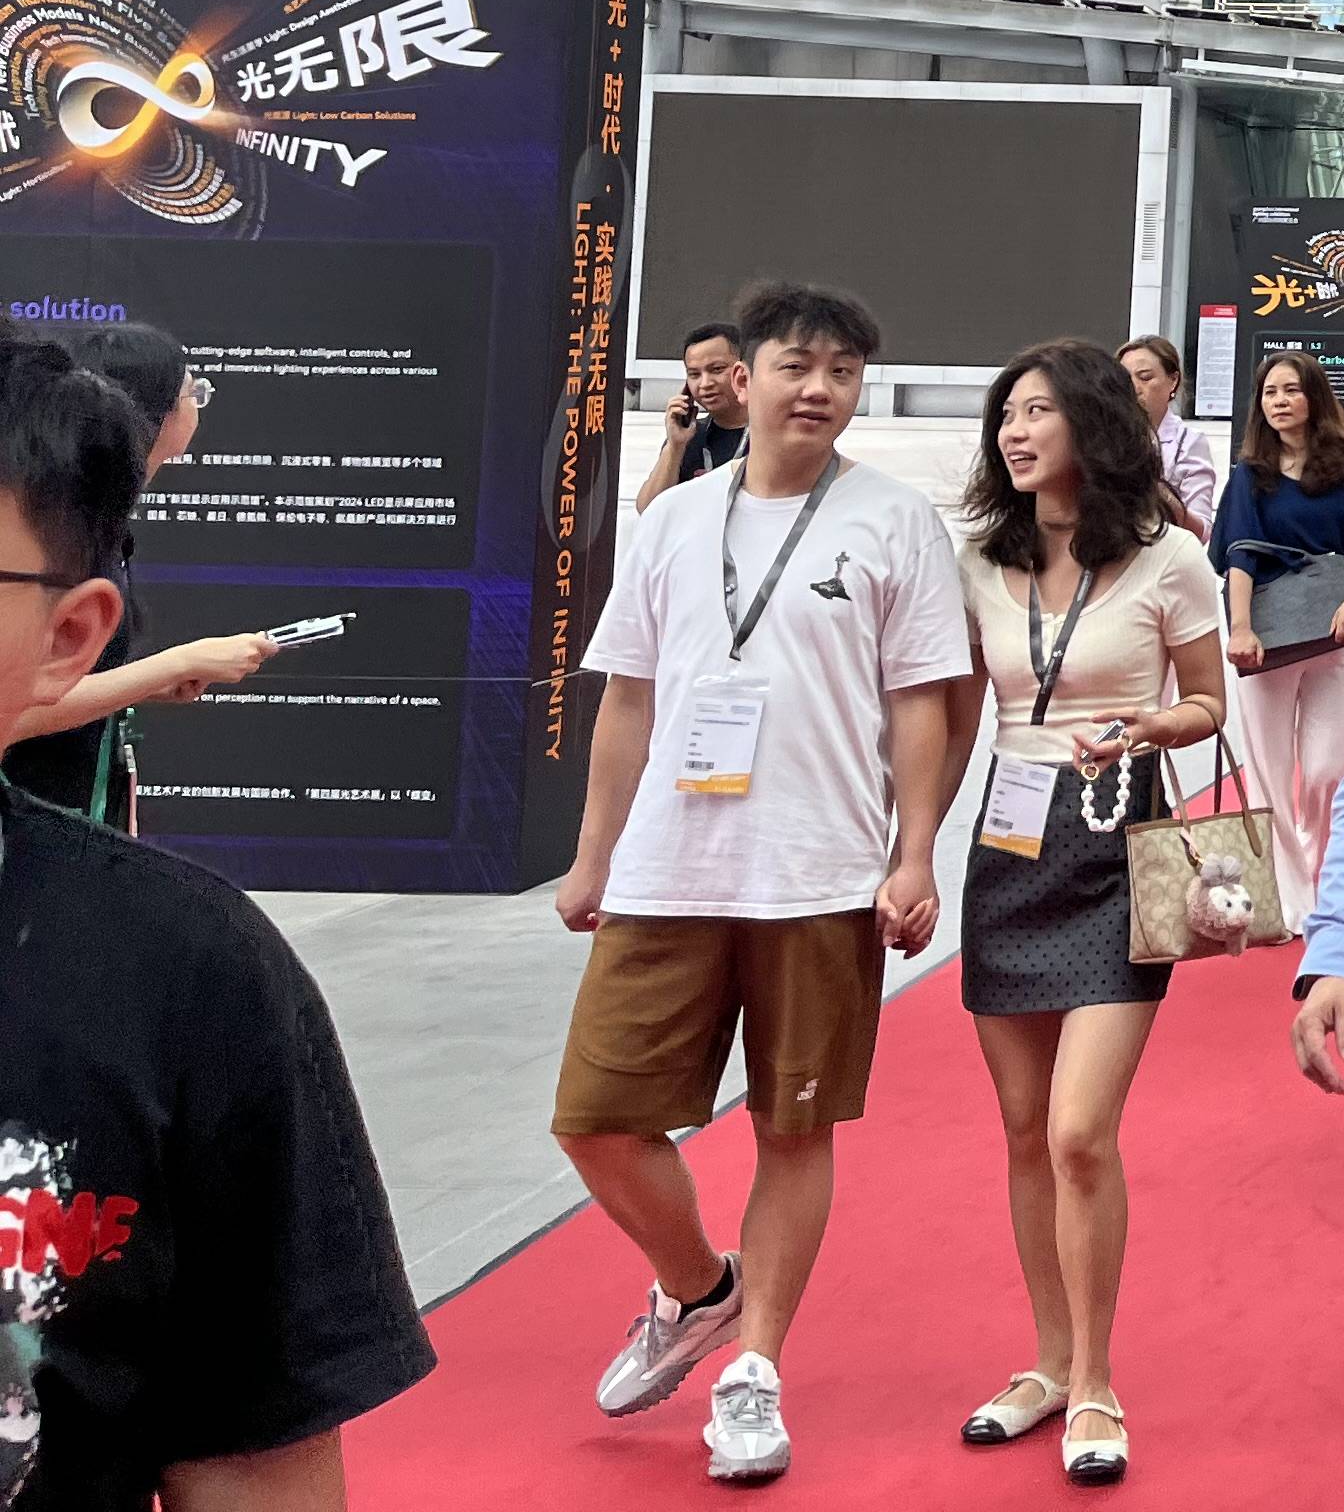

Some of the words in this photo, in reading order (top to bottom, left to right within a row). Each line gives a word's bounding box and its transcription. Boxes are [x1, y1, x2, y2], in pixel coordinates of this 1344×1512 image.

[32, 6, 85, 22] Models
[236, 127, 388, 188] INFINITY
[571, 201, 592, 318] LIGHT:
[10, 296, 125, 320] solution
[565, 328, 584, 396] THE
[558, 407, 580, 539] POWER
[555, 549, 574, 598] OF
[545, 608, 568, 761] INFINITY
